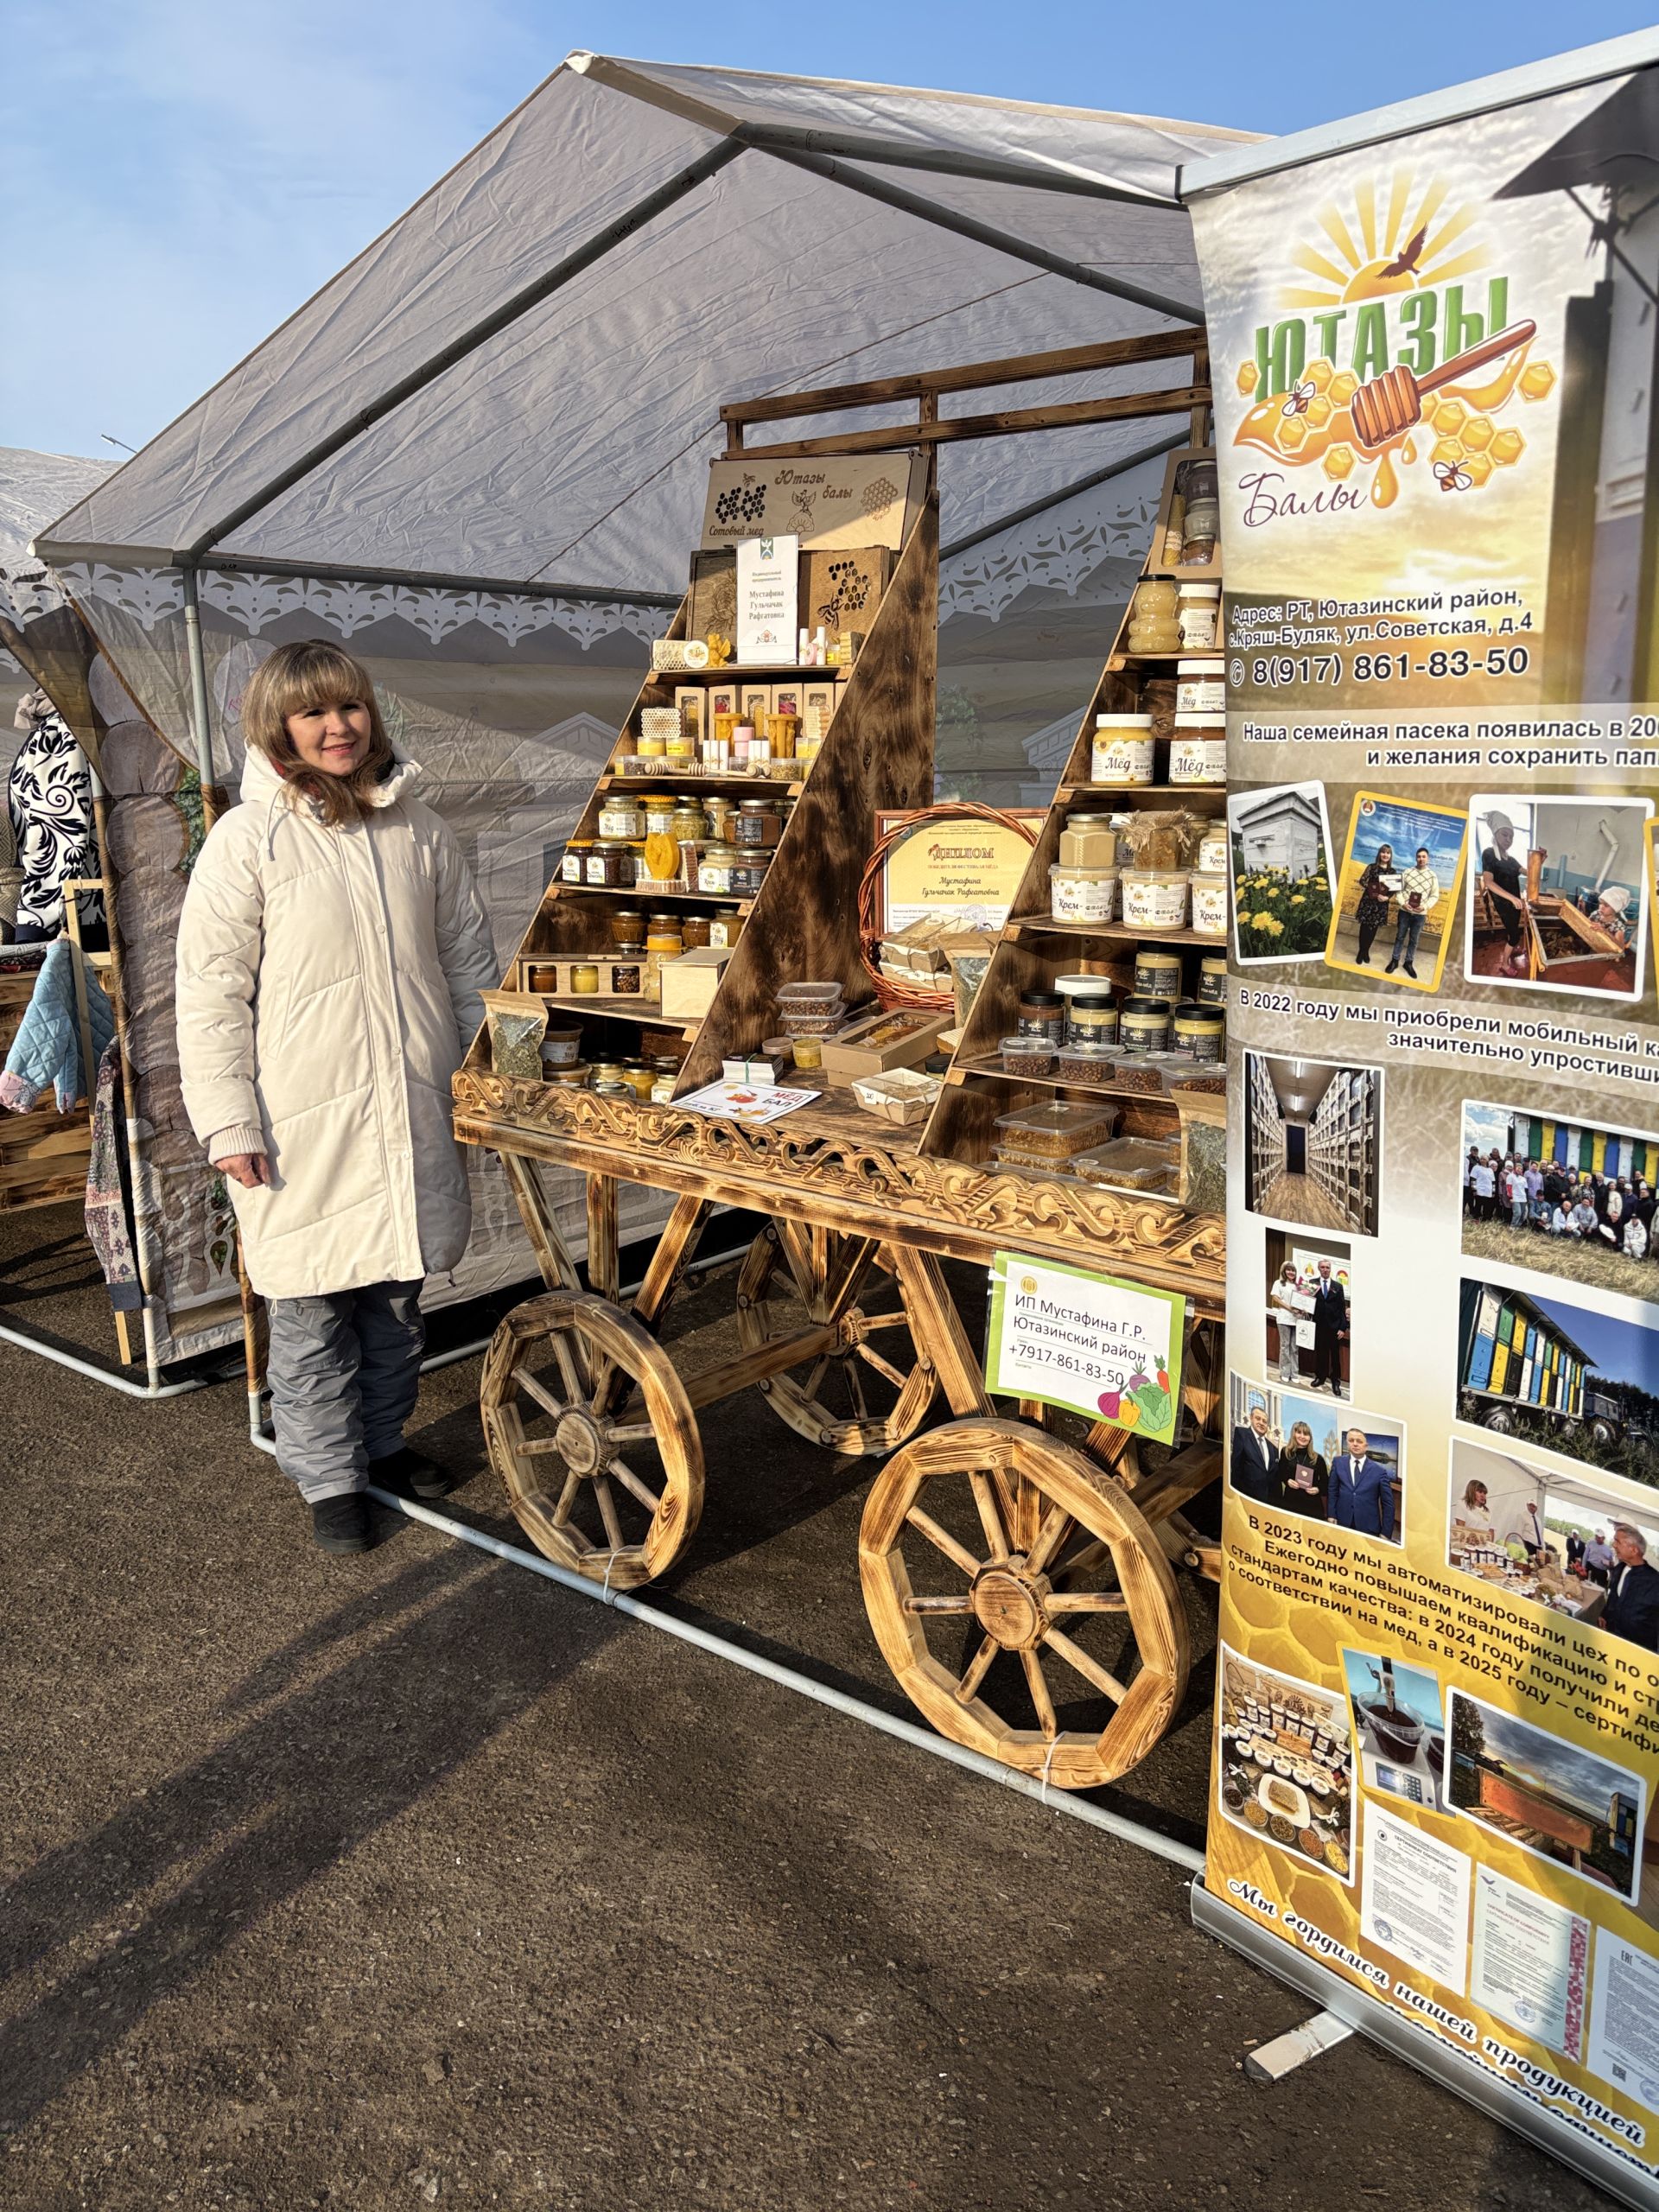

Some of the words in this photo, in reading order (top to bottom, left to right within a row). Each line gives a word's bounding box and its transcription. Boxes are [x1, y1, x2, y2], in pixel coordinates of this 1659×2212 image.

[1255, 276, 1509, 404] ЮТАЗЫ
[774, 469, 826, 486] Ютазы
[822, 485, 854, 499] балы
[1238, 472, 1368, 527] Балы
[709, 524, 746, 537] Сотовый
[746, 528, 765, 537] мед
[749, 589, 785, 600] Мустафина
[1232, 606, 1282, 626] Адрес:
[1287, 601, 1313, 622] РТ,
[1319, 592, 1443, 619] Ютазинский
[1450, 588, 1522, 612] район,
[1229, 627, 1341, 650] с.Кряш-Буляк,
[1345, 615, 1492, 644] ул.Советская,
[1498, 611, 1533, 635] д.4
[1254, 654, 1341, 687] 8(917)
[1353, 646, 1529, 681] 861-83-50
[1243, 723, 1287, 741] Наша
[1293, 721, 1389, 741] семейная
[1395, 724, 1469, 739] пасека
[1477, 721, 1601, 738] появилась
[1610, 722, 1623, 737] в
[1630, 717, 1659, 737] 20
[1104, 757, 1132, 773] Мёд
[1174, 757, 1205, 779] Мёд
[1368, 752, 1380, 765] и
[1386, 750, 1480, 765] желания
[1488, 749, 1608, 768] сохранить
[1616, 750, 1659, 766] пап
[922, 887, 955, 899] Гульчачак
[938, 876, 982, 887] Мустафина
[1058, 898, 1084, 912] Крем-
[1128, 902, 1153, 914] Крем-
[1199, 909, 1225, 921] Крем-
[1241, 989, 1249, 1005] В
[1254, 993, 1291, 1012] 2022
[1296, 1001, 1339, 1021] году
[1346, 1006, 1377, 1021] мы
[1385, 1009, 1501, 1033] приобрели
[1509, 1022, 1638, 1053] мобильный
[1645, 1042, 1659, 1057] к
[1389, 1033, 1524, 1061] значительно
[1015, 1294, 1036, 1310] ИП
[1039, 1300, 1118, 1333] Мустафина
[1122, 1322, 1147, 1341] Г.Р.
[1014, 1315, 1098, 1350] Ютазинский
[1101, 1341, 1147, 1363] район
[1009, 1343, 1125, 1386] +7917-861-83-50
[1249, 1515, 1260, 1530] В
[1264, 1522, 1302, 1545] 2023
[1307, 1537, 1348, 1560] году
[1353, 1551, 1382, 1570] мы
[1387, 1562, 1566, 1647] автоматизировали
[1573, 1640, 1609, 1665] цех
[1615, 1658, 1641, 1679] по
[1229, 1561, 1235, 1571] о
[1238, 1567, 1352, 1616] соответствии
[1357, 1610, 1378, 1625] на
[1383, 1619, 1423, 1647] мед,
[1427, 1638, 1438, 1652] а
[1444, 1646, 1454, 1659] в
[1459, 1649, 1502, 1681] 2025
[1507, 1675, 1550, 1706] году
[1231, 1544, 1323, 1587] стандартам
[1329, 1581, 1413, 1621] качества:
[1419, 1615, 1429, 1628] в
[1434, 1619, 1477, 1648] 2024
[1482, 1642, 1523, 1672] году
[1530, 1663, 1629, 1719] получили
[1265, 1540, 1349, 1578] Ежегодно
[1355, 1571, 1452, 1618] повышаем
[1458, 1611, 1607, 1686] квалификацию
[1614, 1680, 1626, 1695] и
[1230, 1880, 1276, 1916] Мы
[1284, 1913, 1389, 1987] гордимся
[1395, 1984, 1477, 2042] нашей
[1485, 2038, 1645, 2146] продукцией
